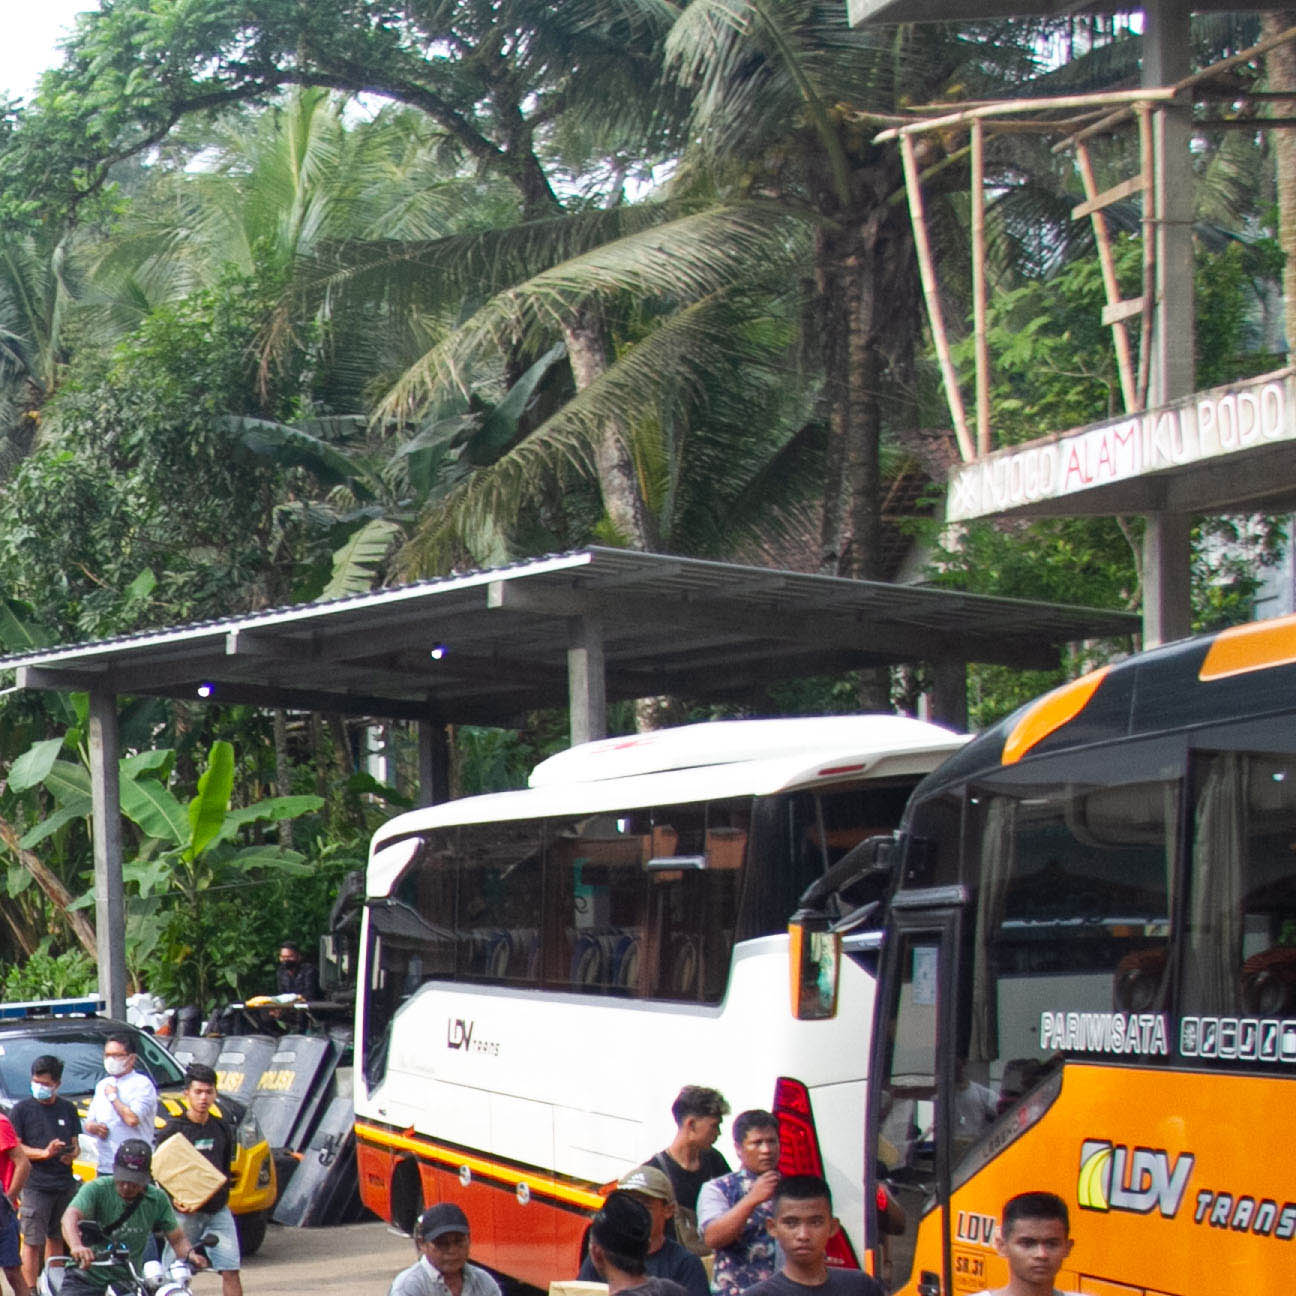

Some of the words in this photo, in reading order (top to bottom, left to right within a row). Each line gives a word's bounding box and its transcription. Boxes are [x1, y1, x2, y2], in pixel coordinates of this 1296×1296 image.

[1197, 383, 1286, 456] PODO
[448, 1017, 474, 1052] LDV
[1040, 1011, 1168, 1055] PARIWISATA
[1109, 1144, 1195, 1219] LDV
[956, 1211, 996, 1246] LDV
